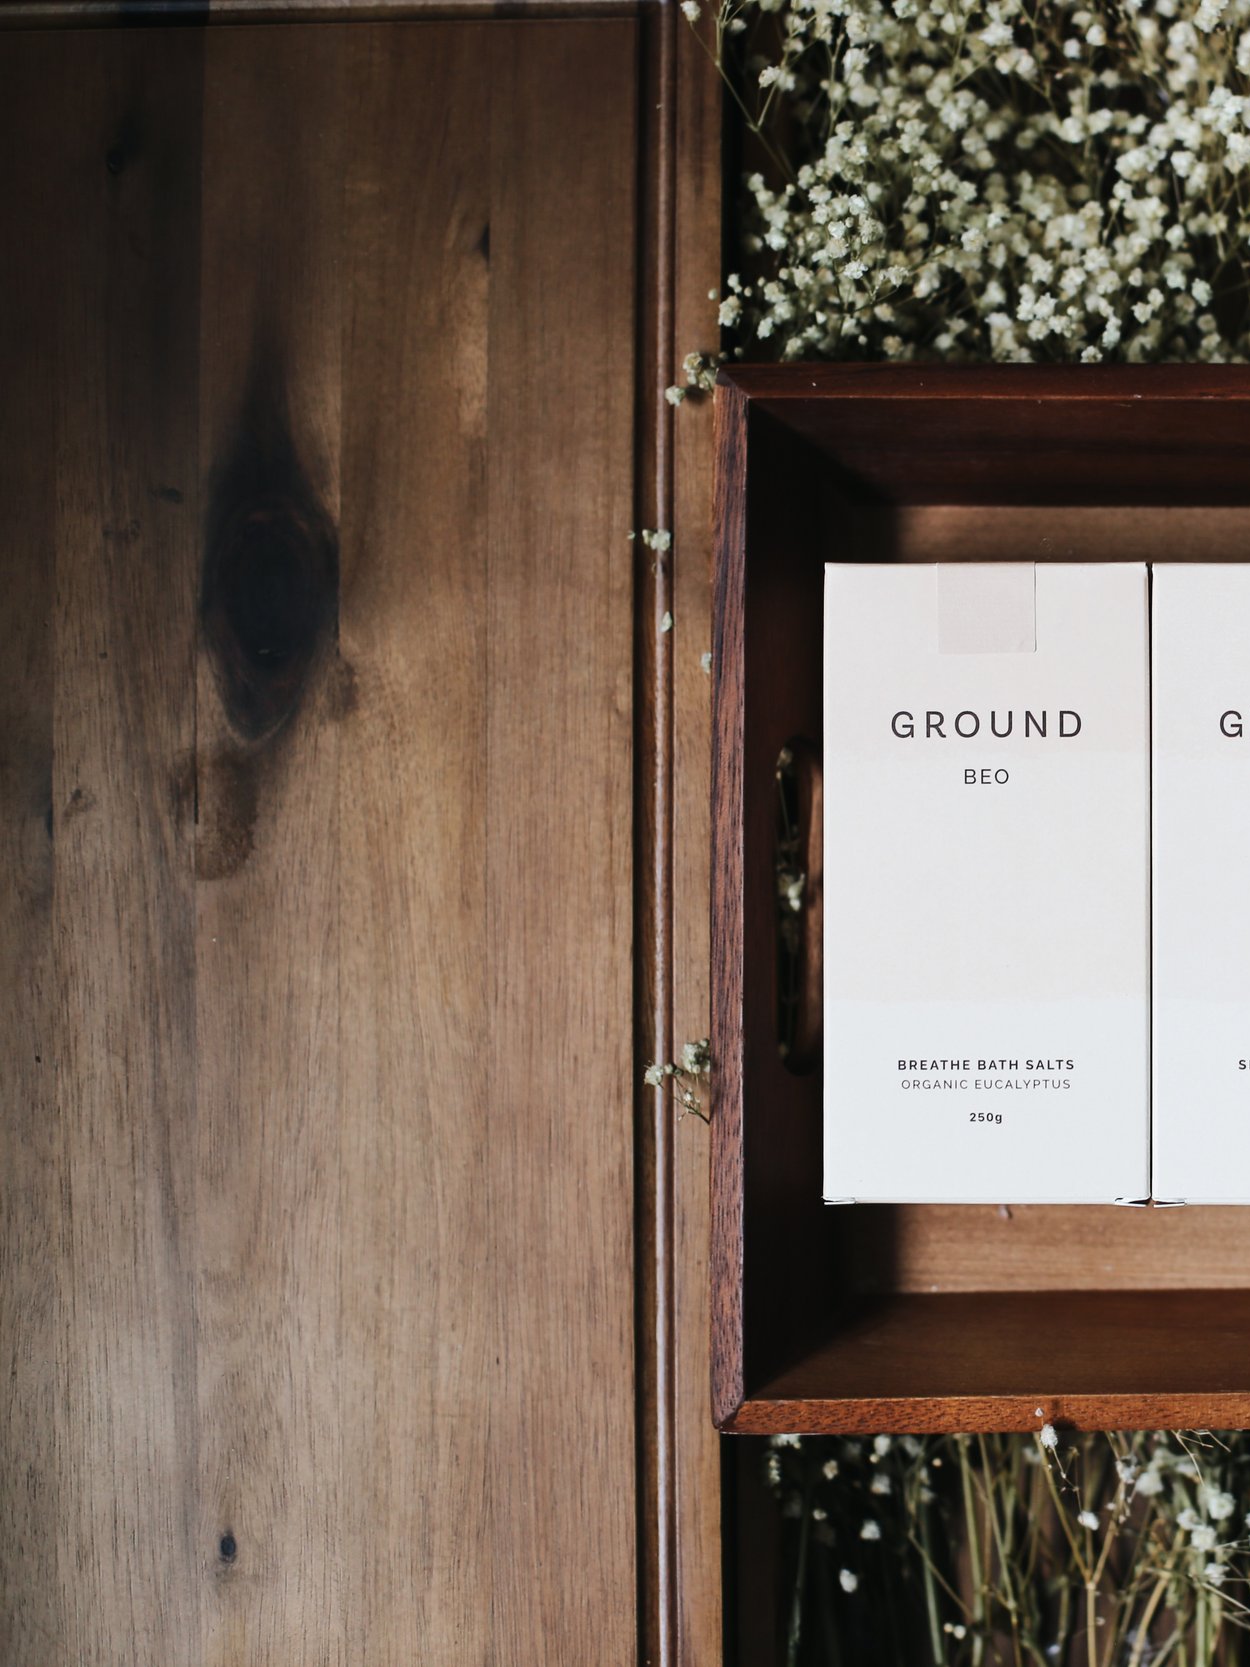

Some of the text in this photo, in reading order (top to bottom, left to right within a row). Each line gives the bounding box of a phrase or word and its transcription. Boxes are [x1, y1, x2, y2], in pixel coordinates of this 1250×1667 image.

[890, 709, 1082, 739] GROUND
[964, 768, 1010, 785] BEO
[897, 1059, 1075, 1071] BREATHE BATH SALTS
[901, 1078, 1071, 1090] ORGANIC EUCALYPTUS
[969, 1112, 1003, 1125] 250g
